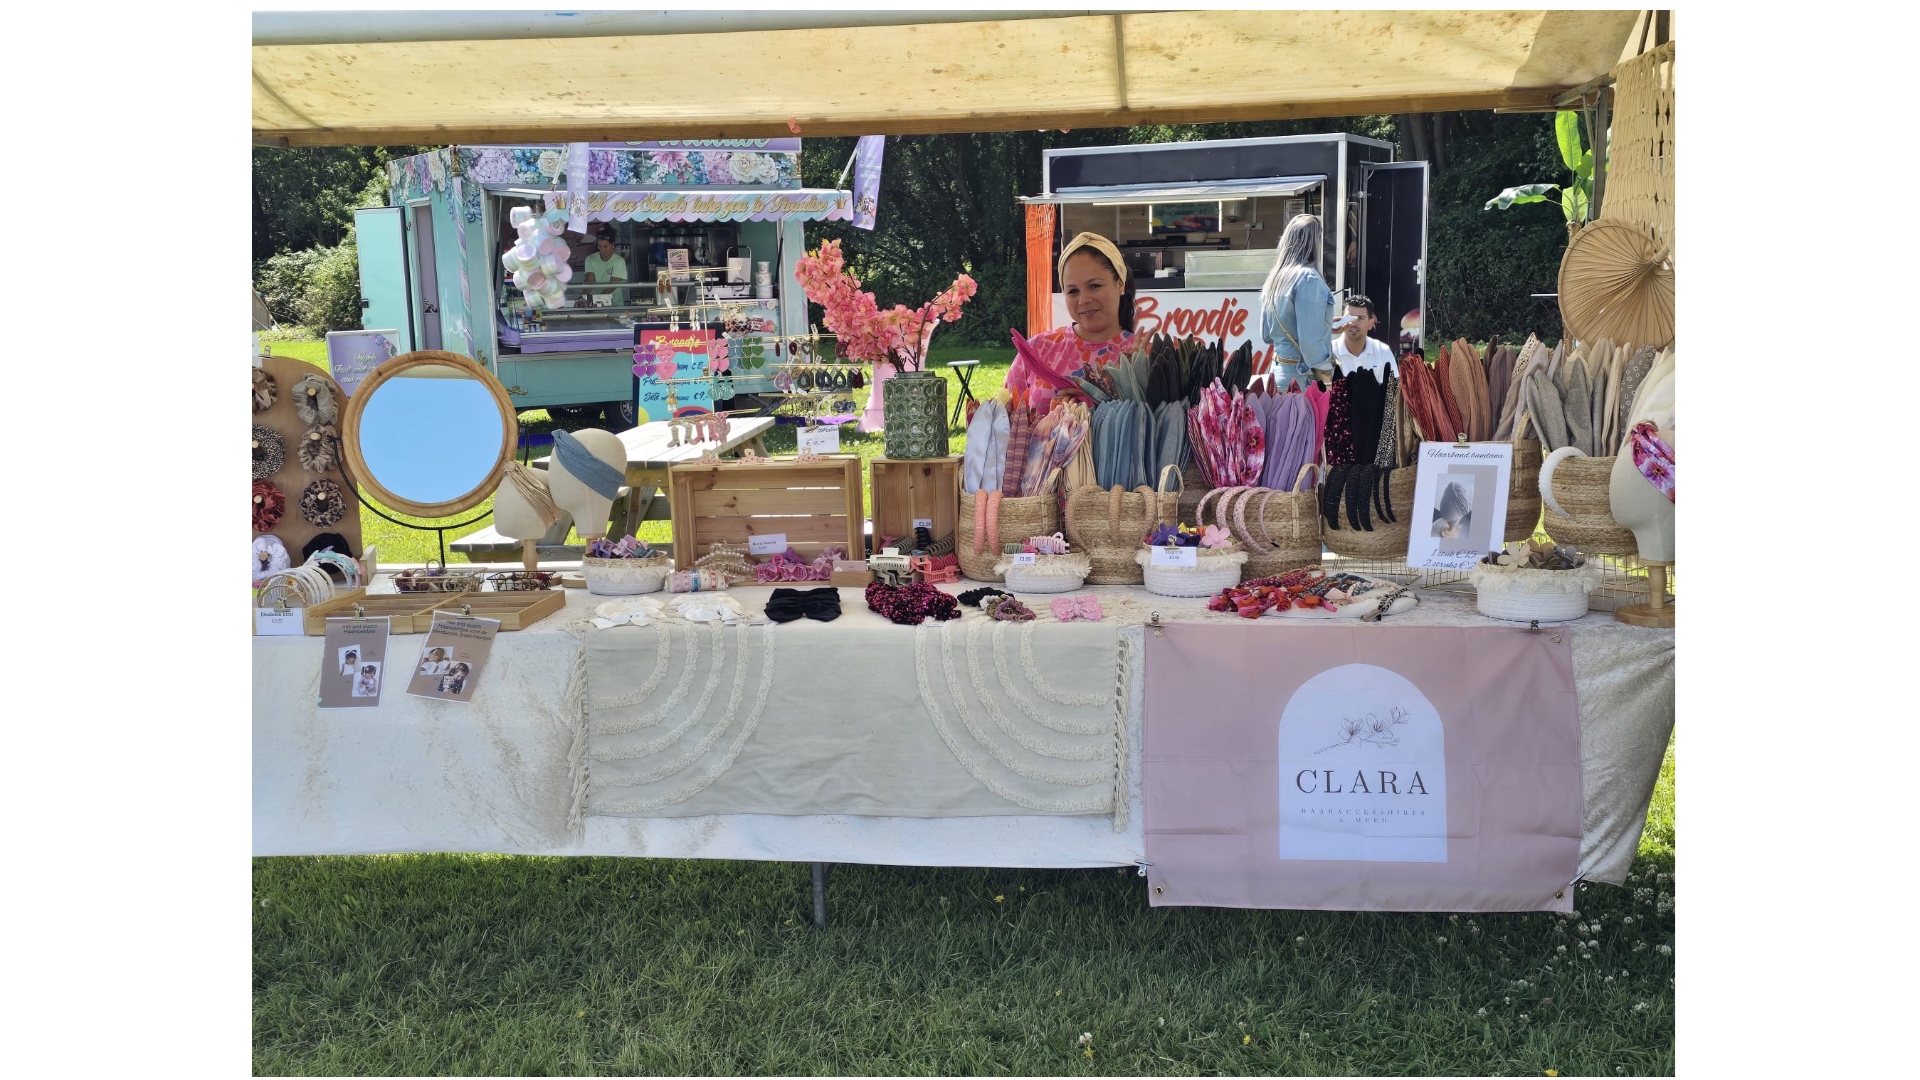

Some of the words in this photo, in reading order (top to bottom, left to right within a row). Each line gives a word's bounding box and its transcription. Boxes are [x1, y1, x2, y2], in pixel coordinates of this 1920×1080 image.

[640, 191, 687, 213] Sweets
[1134, 296, 1249, 344] Broodje
[1427, 448, 1470, 458] Haarband
[1470, 451, 1504, 459] bandana
[1296, 769, 1429, 795] CLARA
